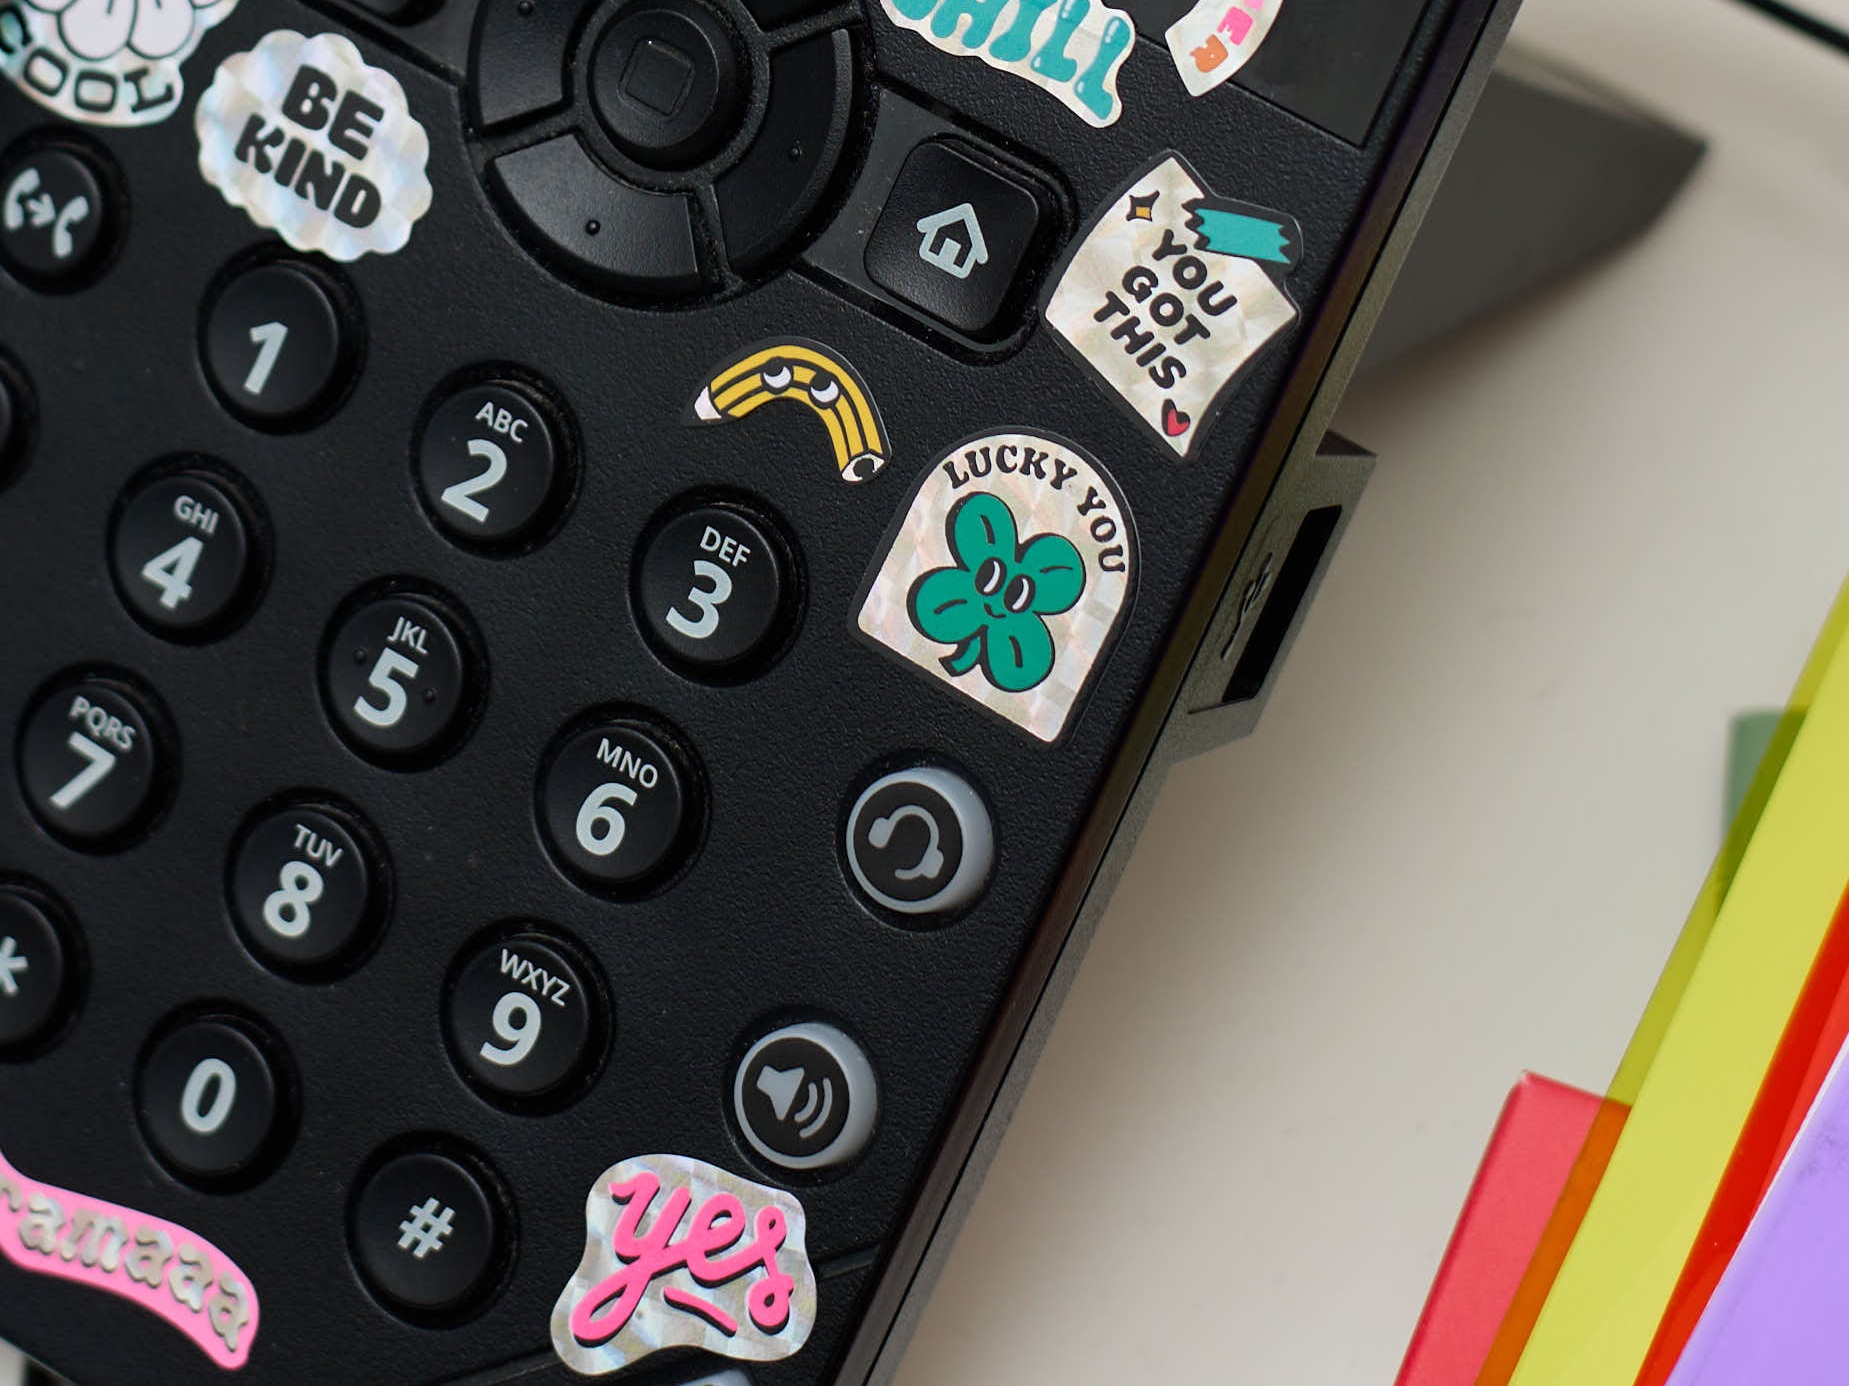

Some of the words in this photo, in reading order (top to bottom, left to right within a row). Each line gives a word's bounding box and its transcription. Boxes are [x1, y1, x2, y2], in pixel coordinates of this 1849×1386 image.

[0, 3, 175, 113] COOL
[282, 64, 385, 161] BE
[234, 112, 382, 229] KIND
[1121, 265, 1211, 345] GOT
[1151, 228, 1238, 317] YOU
[243, 320, 289, 396] 1
[1093, 290, 1188, 389] THIS
[474, 400, 530, 445] ABC
[173, 494, 220, 536] GHI
[440, 437, 509, 525] 2
[942, 444, 1078, 490] LUCKY
[1076, 485, 1127, 574] YOU
[140, 535, 205, 611] 4
[699, 525, 752, 568] DEF
[386, 616, 430, 656] JKL
[665, 559, 733, 640] 3
[68, 694, 139, 753] PQRS
[353, 646, 421, 729] 5
[49, 730, 118, 811] 7
[596, 736, 659, 790] MNO
[293, 823, 344, 869] TUV
[575, 782, 639, 857] 6
[262, 860, 326, 938] 8
[500, 947, 571, 1007] WXYZ
[479, 991, 542, 1066] 9
[180, 1057, 238, 1135] 0
[397, 1196, 457, 1260] #
[569, 1171, 795, 1349] yes
